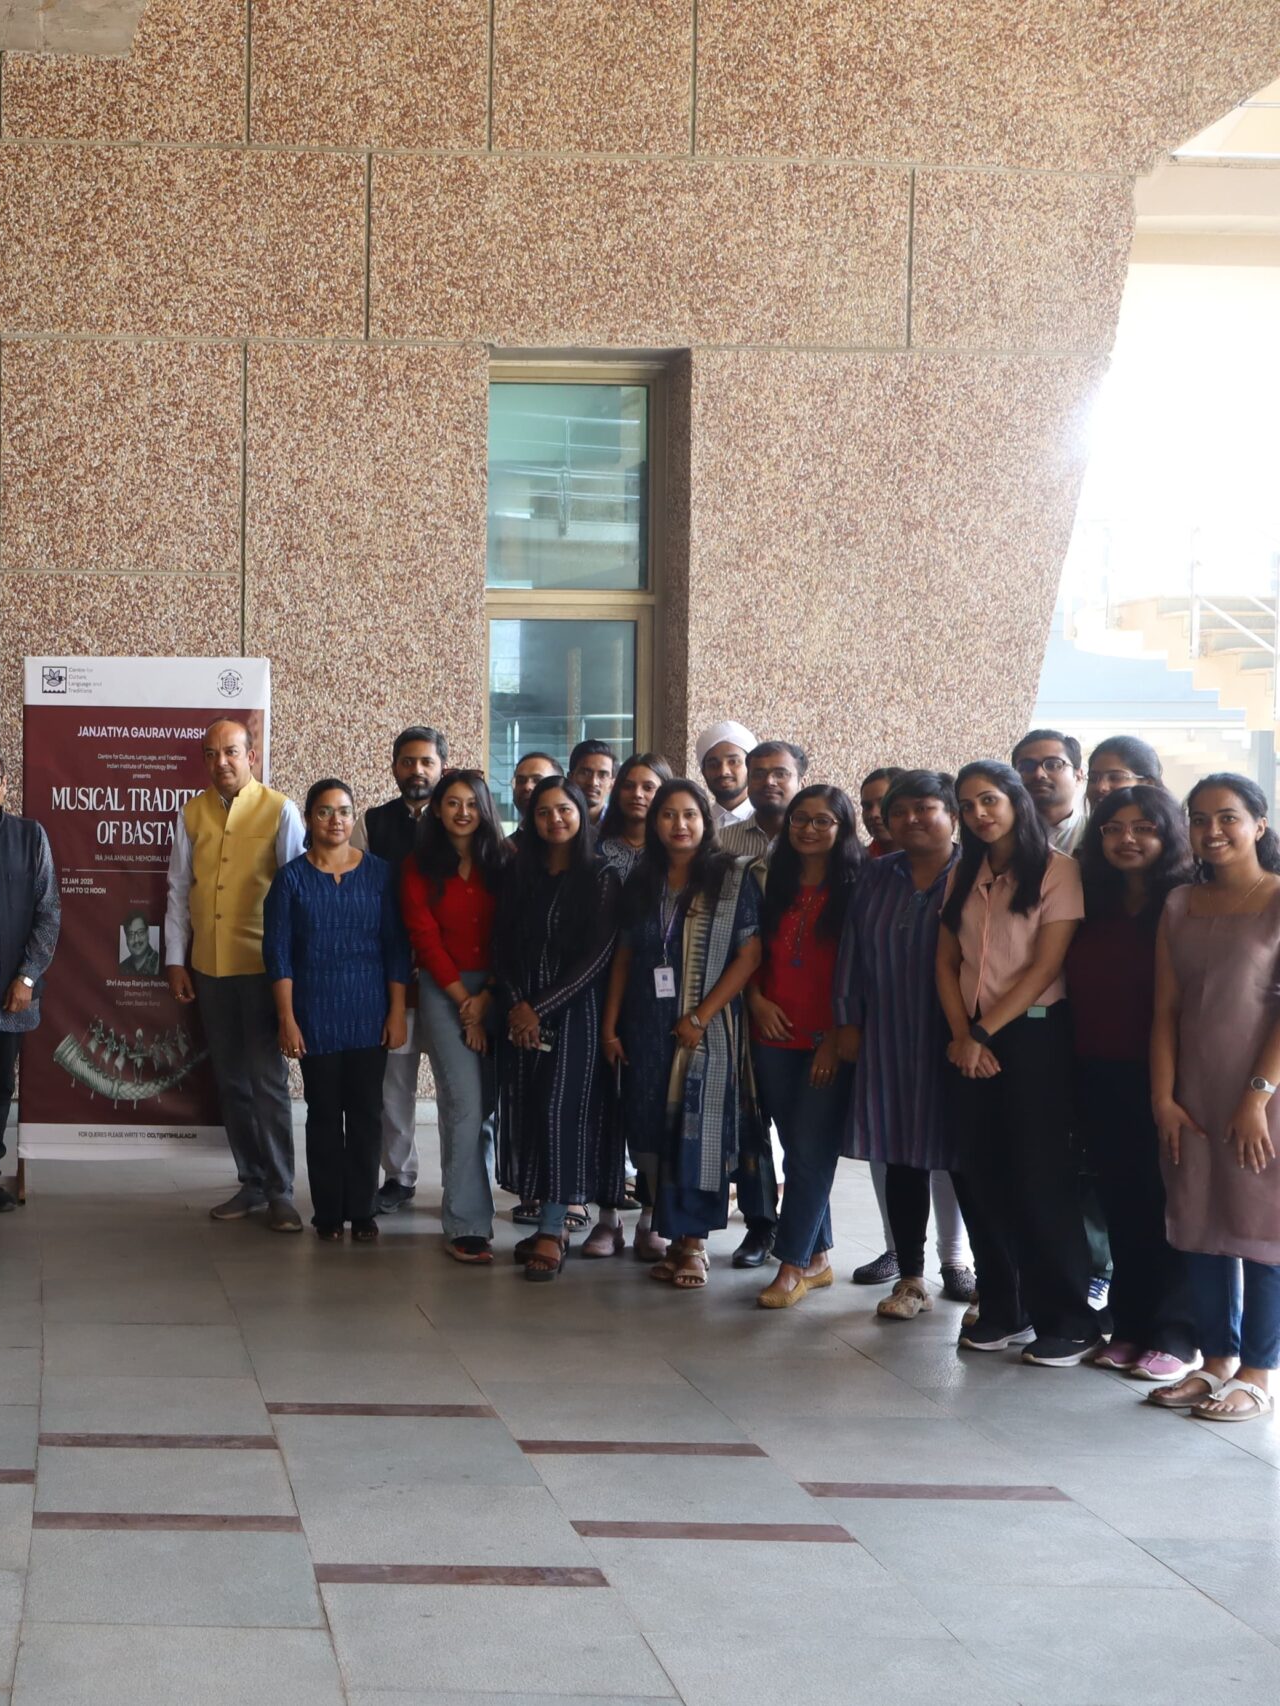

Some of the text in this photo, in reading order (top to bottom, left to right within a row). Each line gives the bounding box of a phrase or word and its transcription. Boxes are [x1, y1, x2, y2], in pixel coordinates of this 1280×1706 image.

[77, 726, 129, 738] JANJATIYA
[130, 727, 173, 739] GAURAV
[51, 786, 125, 811] MUSICAL
[96, 820, 176, 845] OF BASTA
[117, 979, 131, 988] Anup
[132, 979, 150, 988] Ranjan
